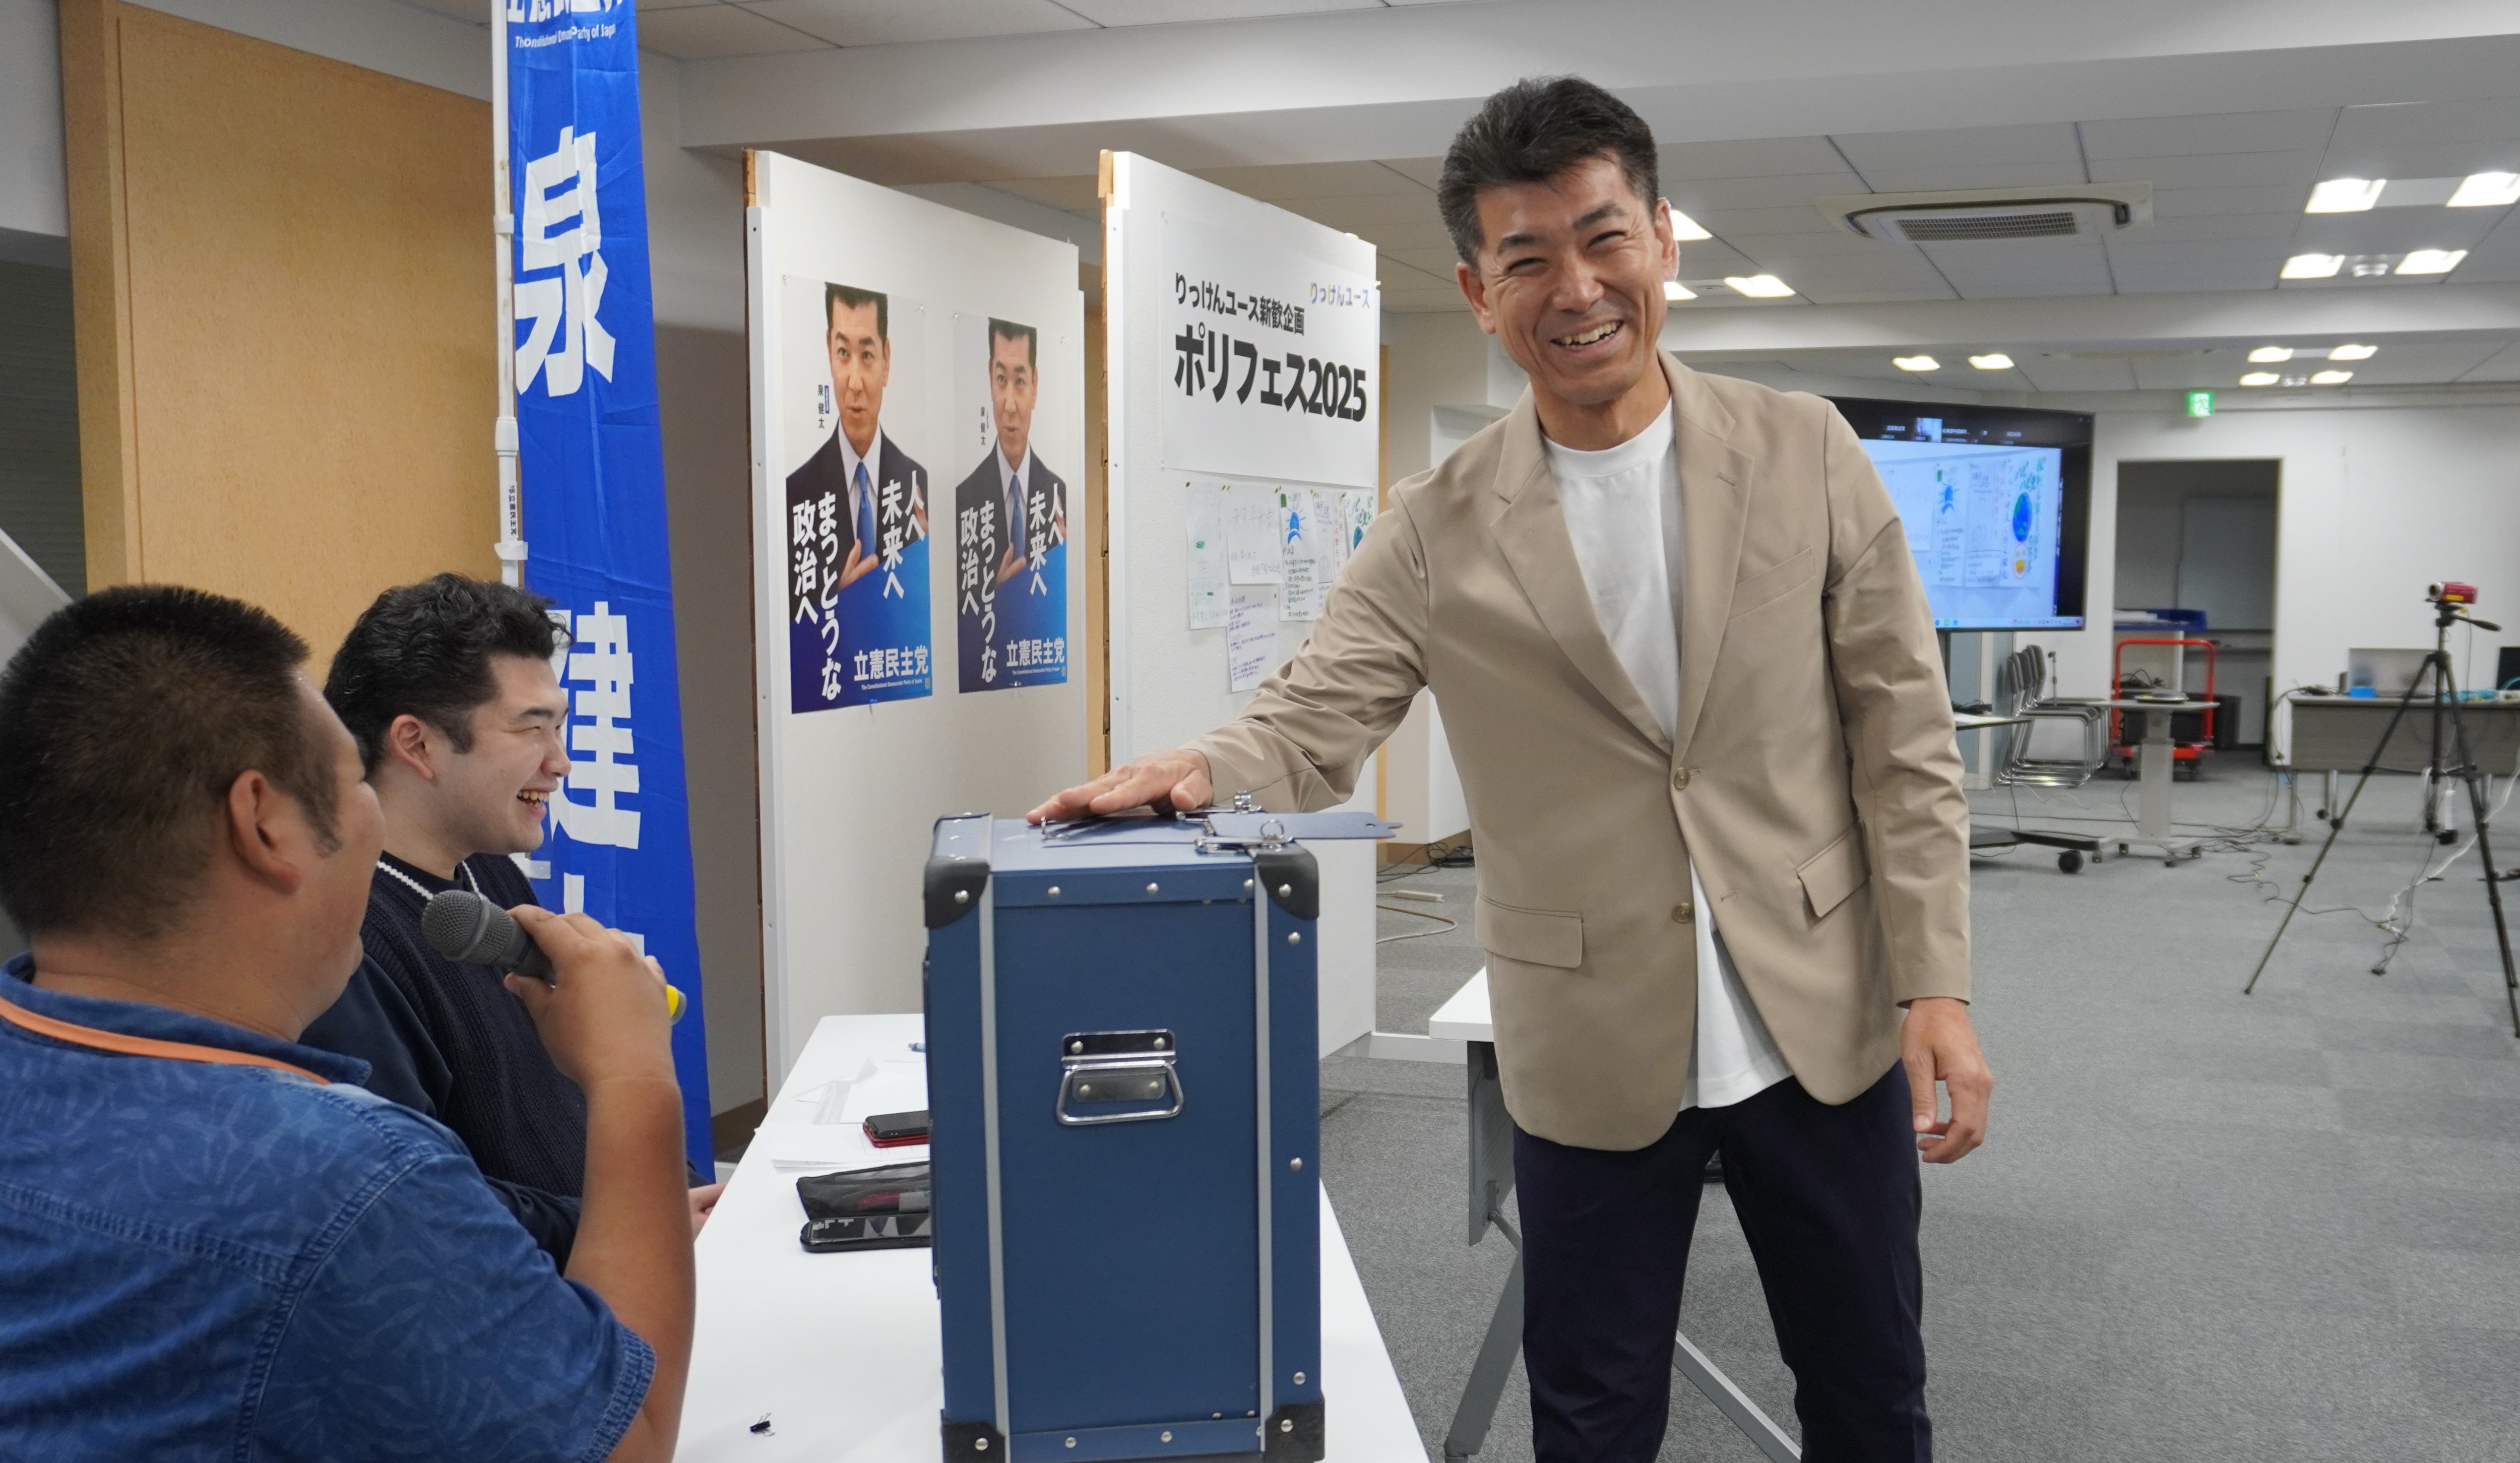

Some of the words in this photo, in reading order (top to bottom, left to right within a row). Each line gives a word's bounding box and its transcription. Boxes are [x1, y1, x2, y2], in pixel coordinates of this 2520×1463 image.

[591, 25, 599, 38] of
[514, 125, 616, 398] 泉
[1175, 272, 1305, 336] りっけんユース新歓企画
[1310, 281, 1370, 309] りっけんユース
[1174, 321, 1367, 422] ポリフェス2025
[881, 479, 905, 599] 未来へ
[905, 470, 925, 542] 人へ
[1030, 490, 1048, 596] 未来へ
[1047, 482, 1064, 546] 人へ
[792, 499, 818, 625] 政治へ
[818, 491, 842, 702] まっとうな
[961, 506, 980, 616] 政治へ
[979, 499, 997, 683] まっとうな
[854, 645, 928, 682] 立憲民主党
[1006, 637, 1064, 667] 立憲民主党
